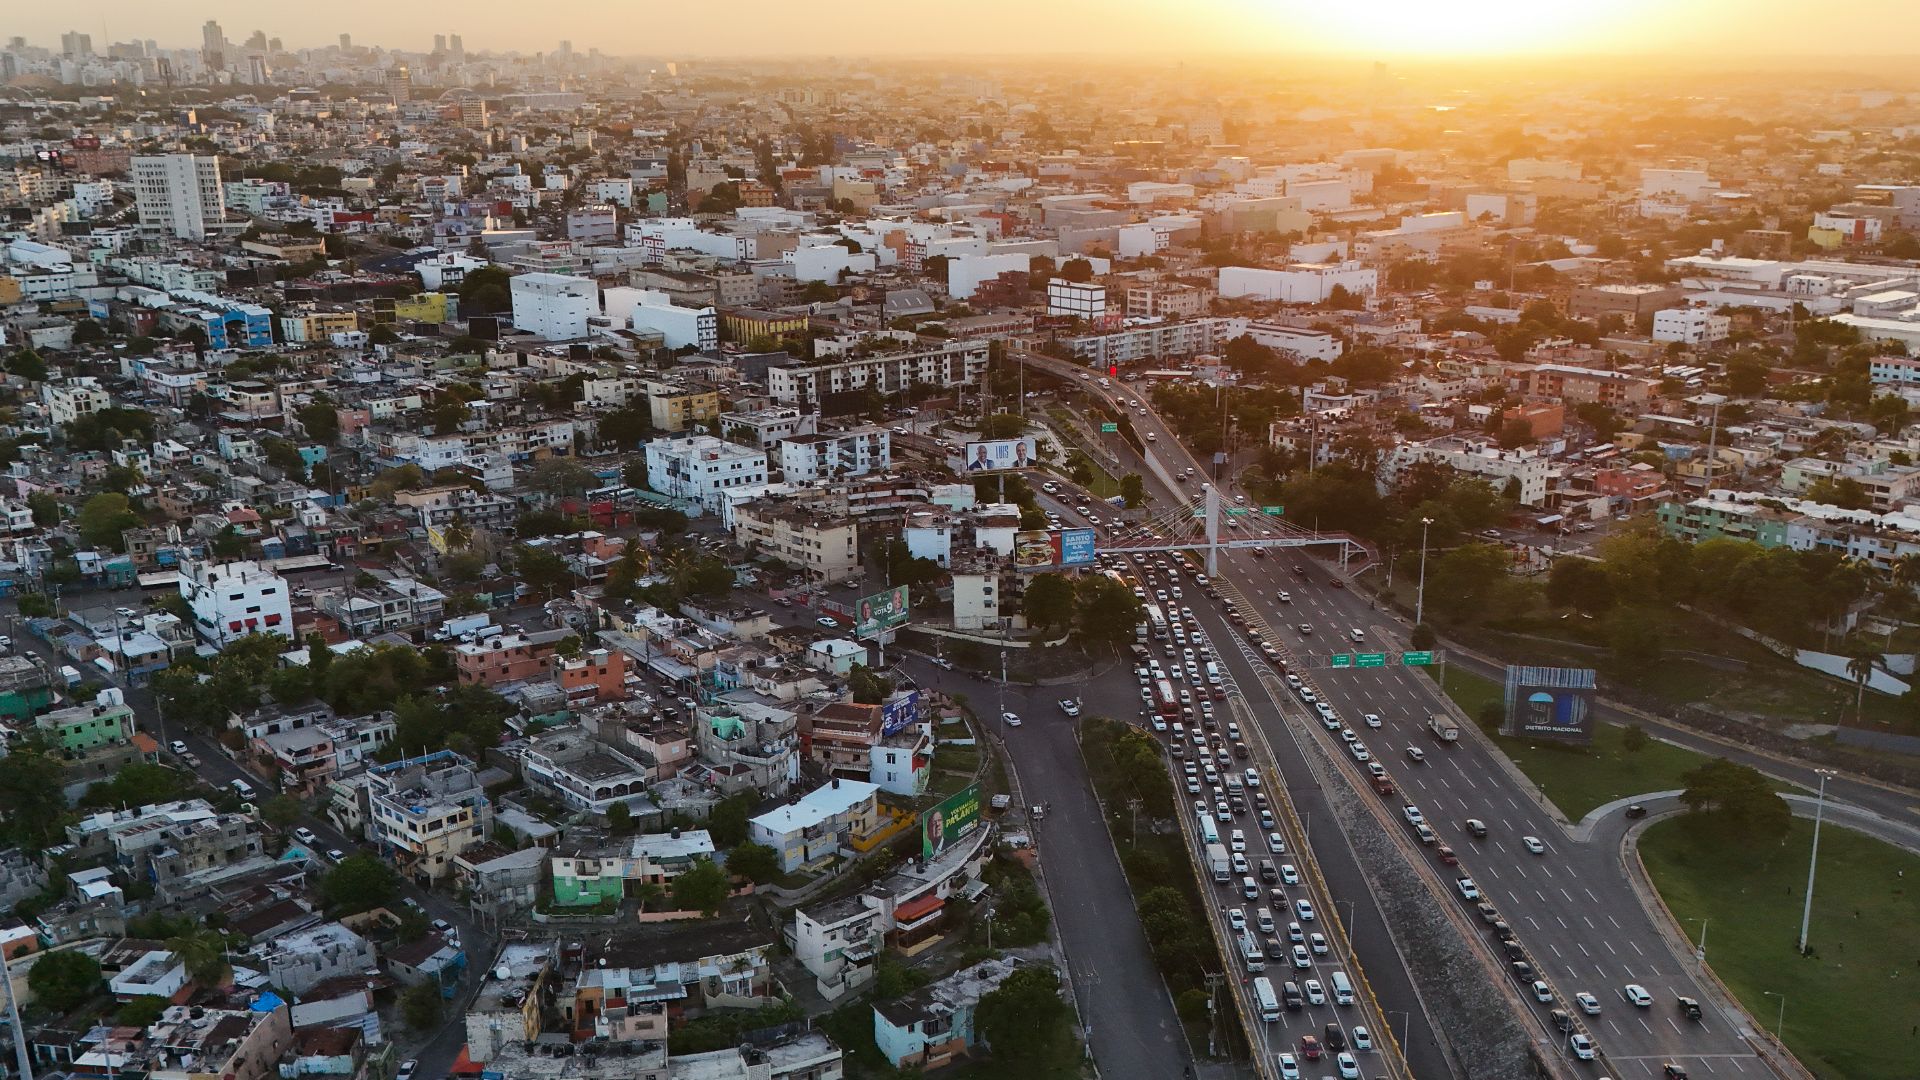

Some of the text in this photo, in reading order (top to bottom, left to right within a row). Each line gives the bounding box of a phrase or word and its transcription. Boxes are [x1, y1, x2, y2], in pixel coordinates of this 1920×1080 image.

[995, 445, 1009, 459] LUIS
[874, 607, 888, 615] VOTA
[887, 602, 893, 613] 9
